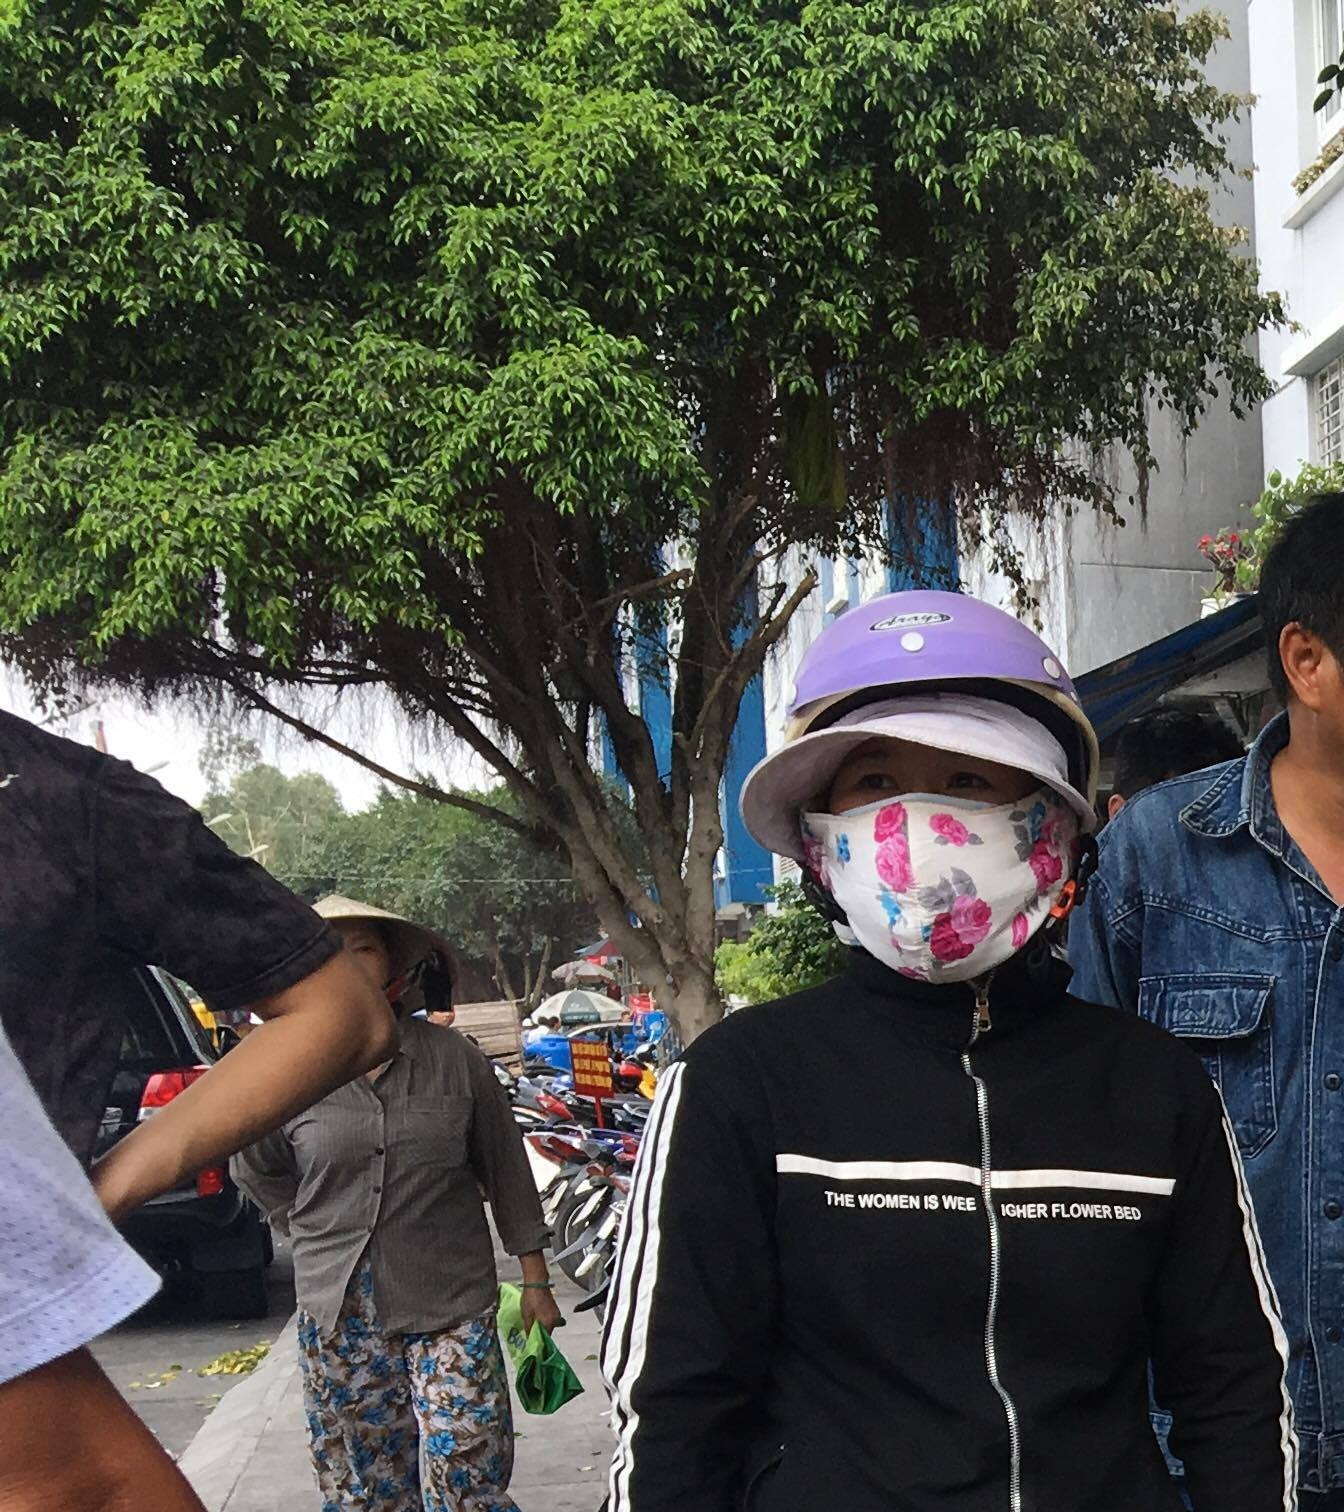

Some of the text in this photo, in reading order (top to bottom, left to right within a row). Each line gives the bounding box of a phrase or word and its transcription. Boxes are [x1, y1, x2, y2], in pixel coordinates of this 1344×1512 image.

[824, 1190, 1143, 1221] THE WOMEN IS WEE IGHER FLOWER BED
